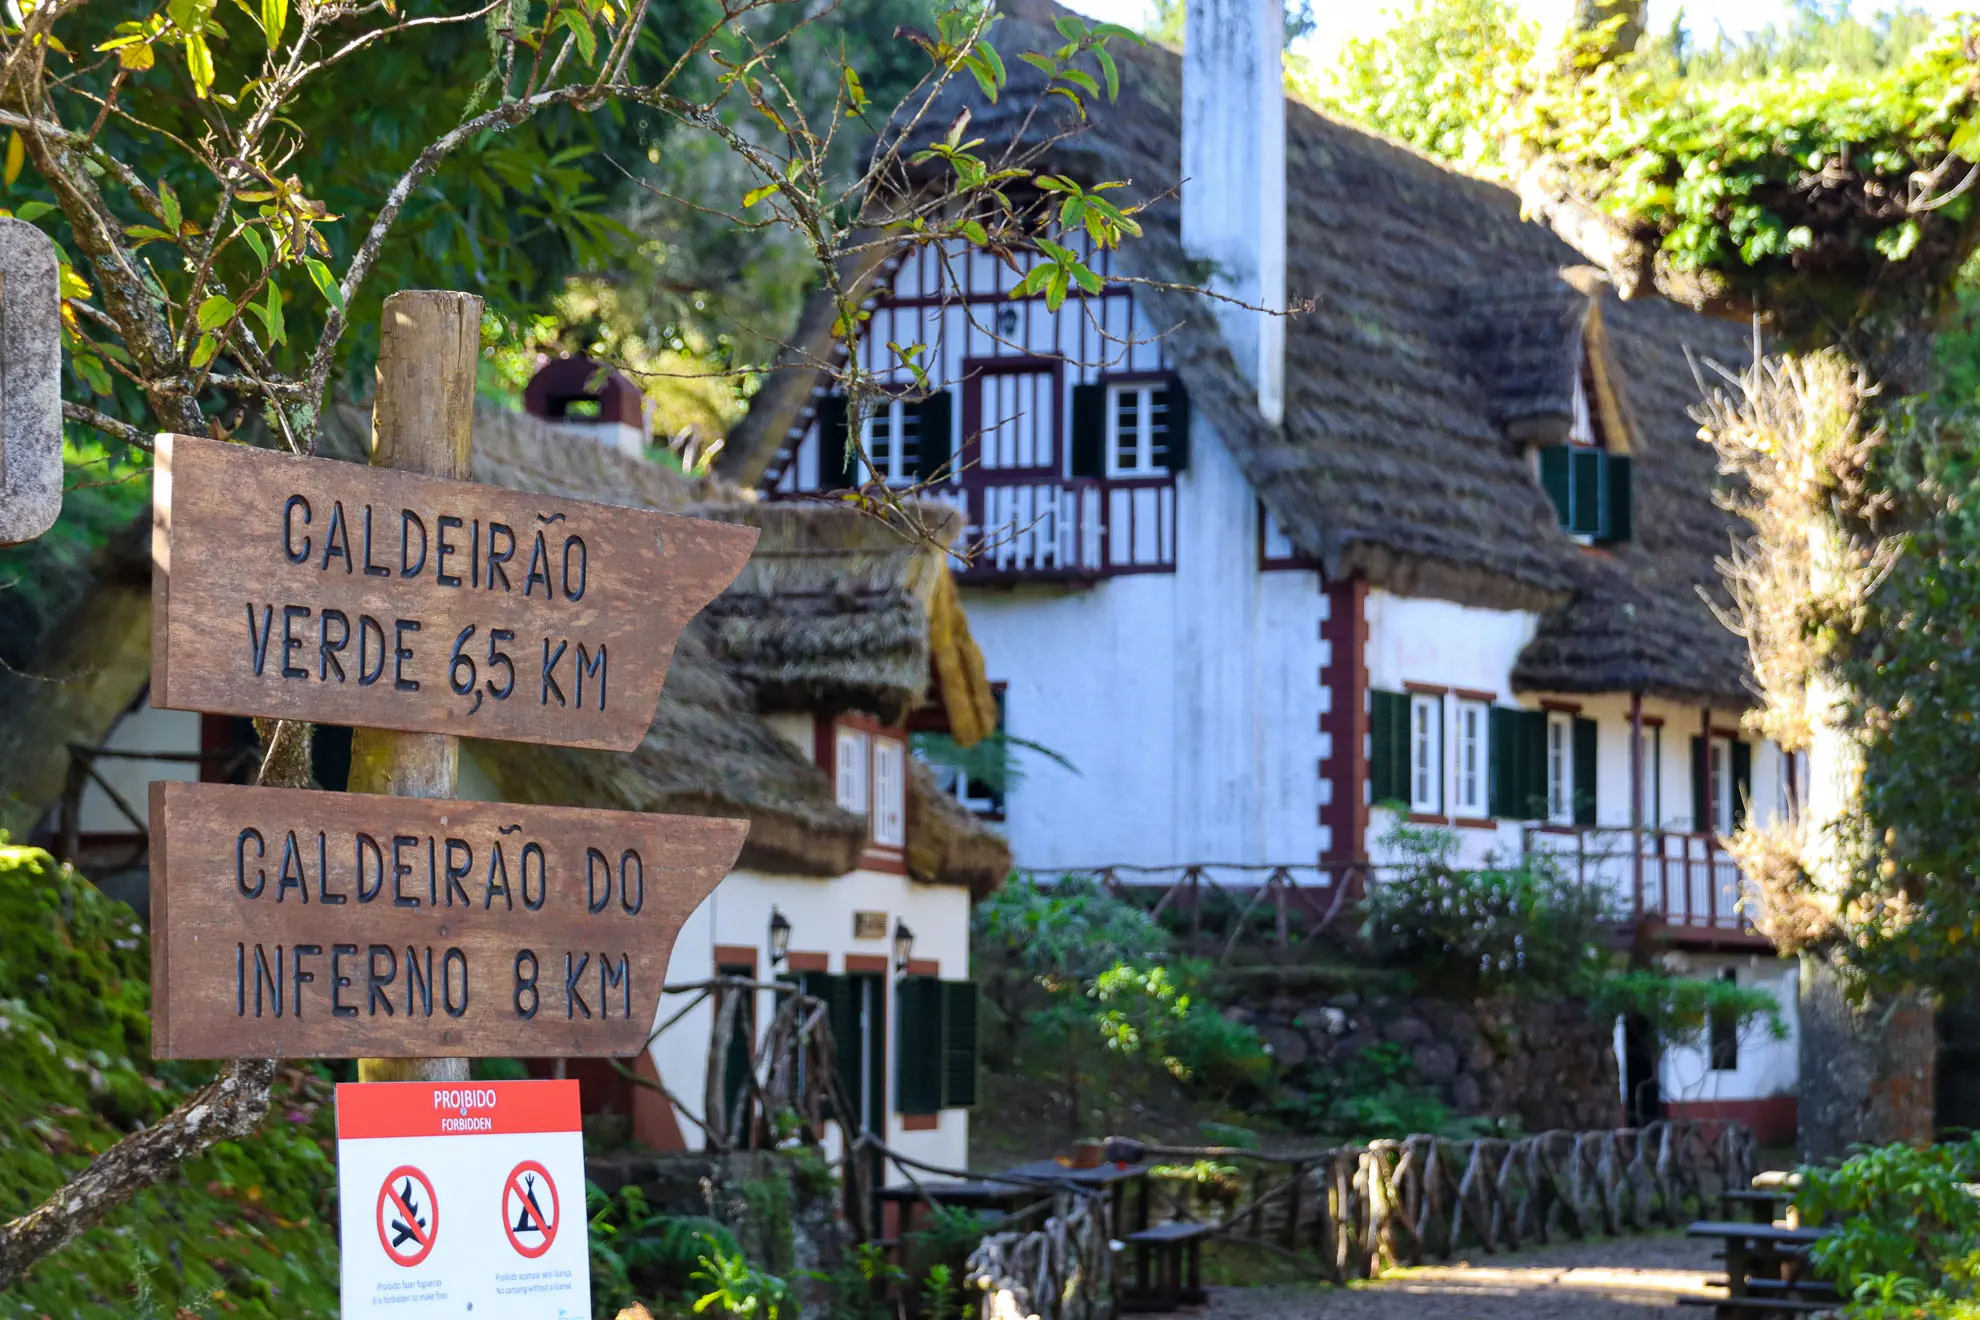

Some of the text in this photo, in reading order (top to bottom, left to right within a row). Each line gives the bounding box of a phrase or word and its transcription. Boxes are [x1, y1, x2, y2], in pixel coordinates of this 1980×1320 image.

[282, 493, 587, 602] CALDEIRÃO
[245, 602, 608, 716] VERDE 6,5 KM
[235, 823, 644, 916] CALDEIRÃO DO
[236, 941, 631, 1020] INFERNO 8 KM
[433, 1089, 497, 1109] PROIBIDO
[441, 1117, 492, 1131] FORBIDDEN
[383, 1294, 411, 1305] forbidden
[505, 1286, 528, 1296] camping
